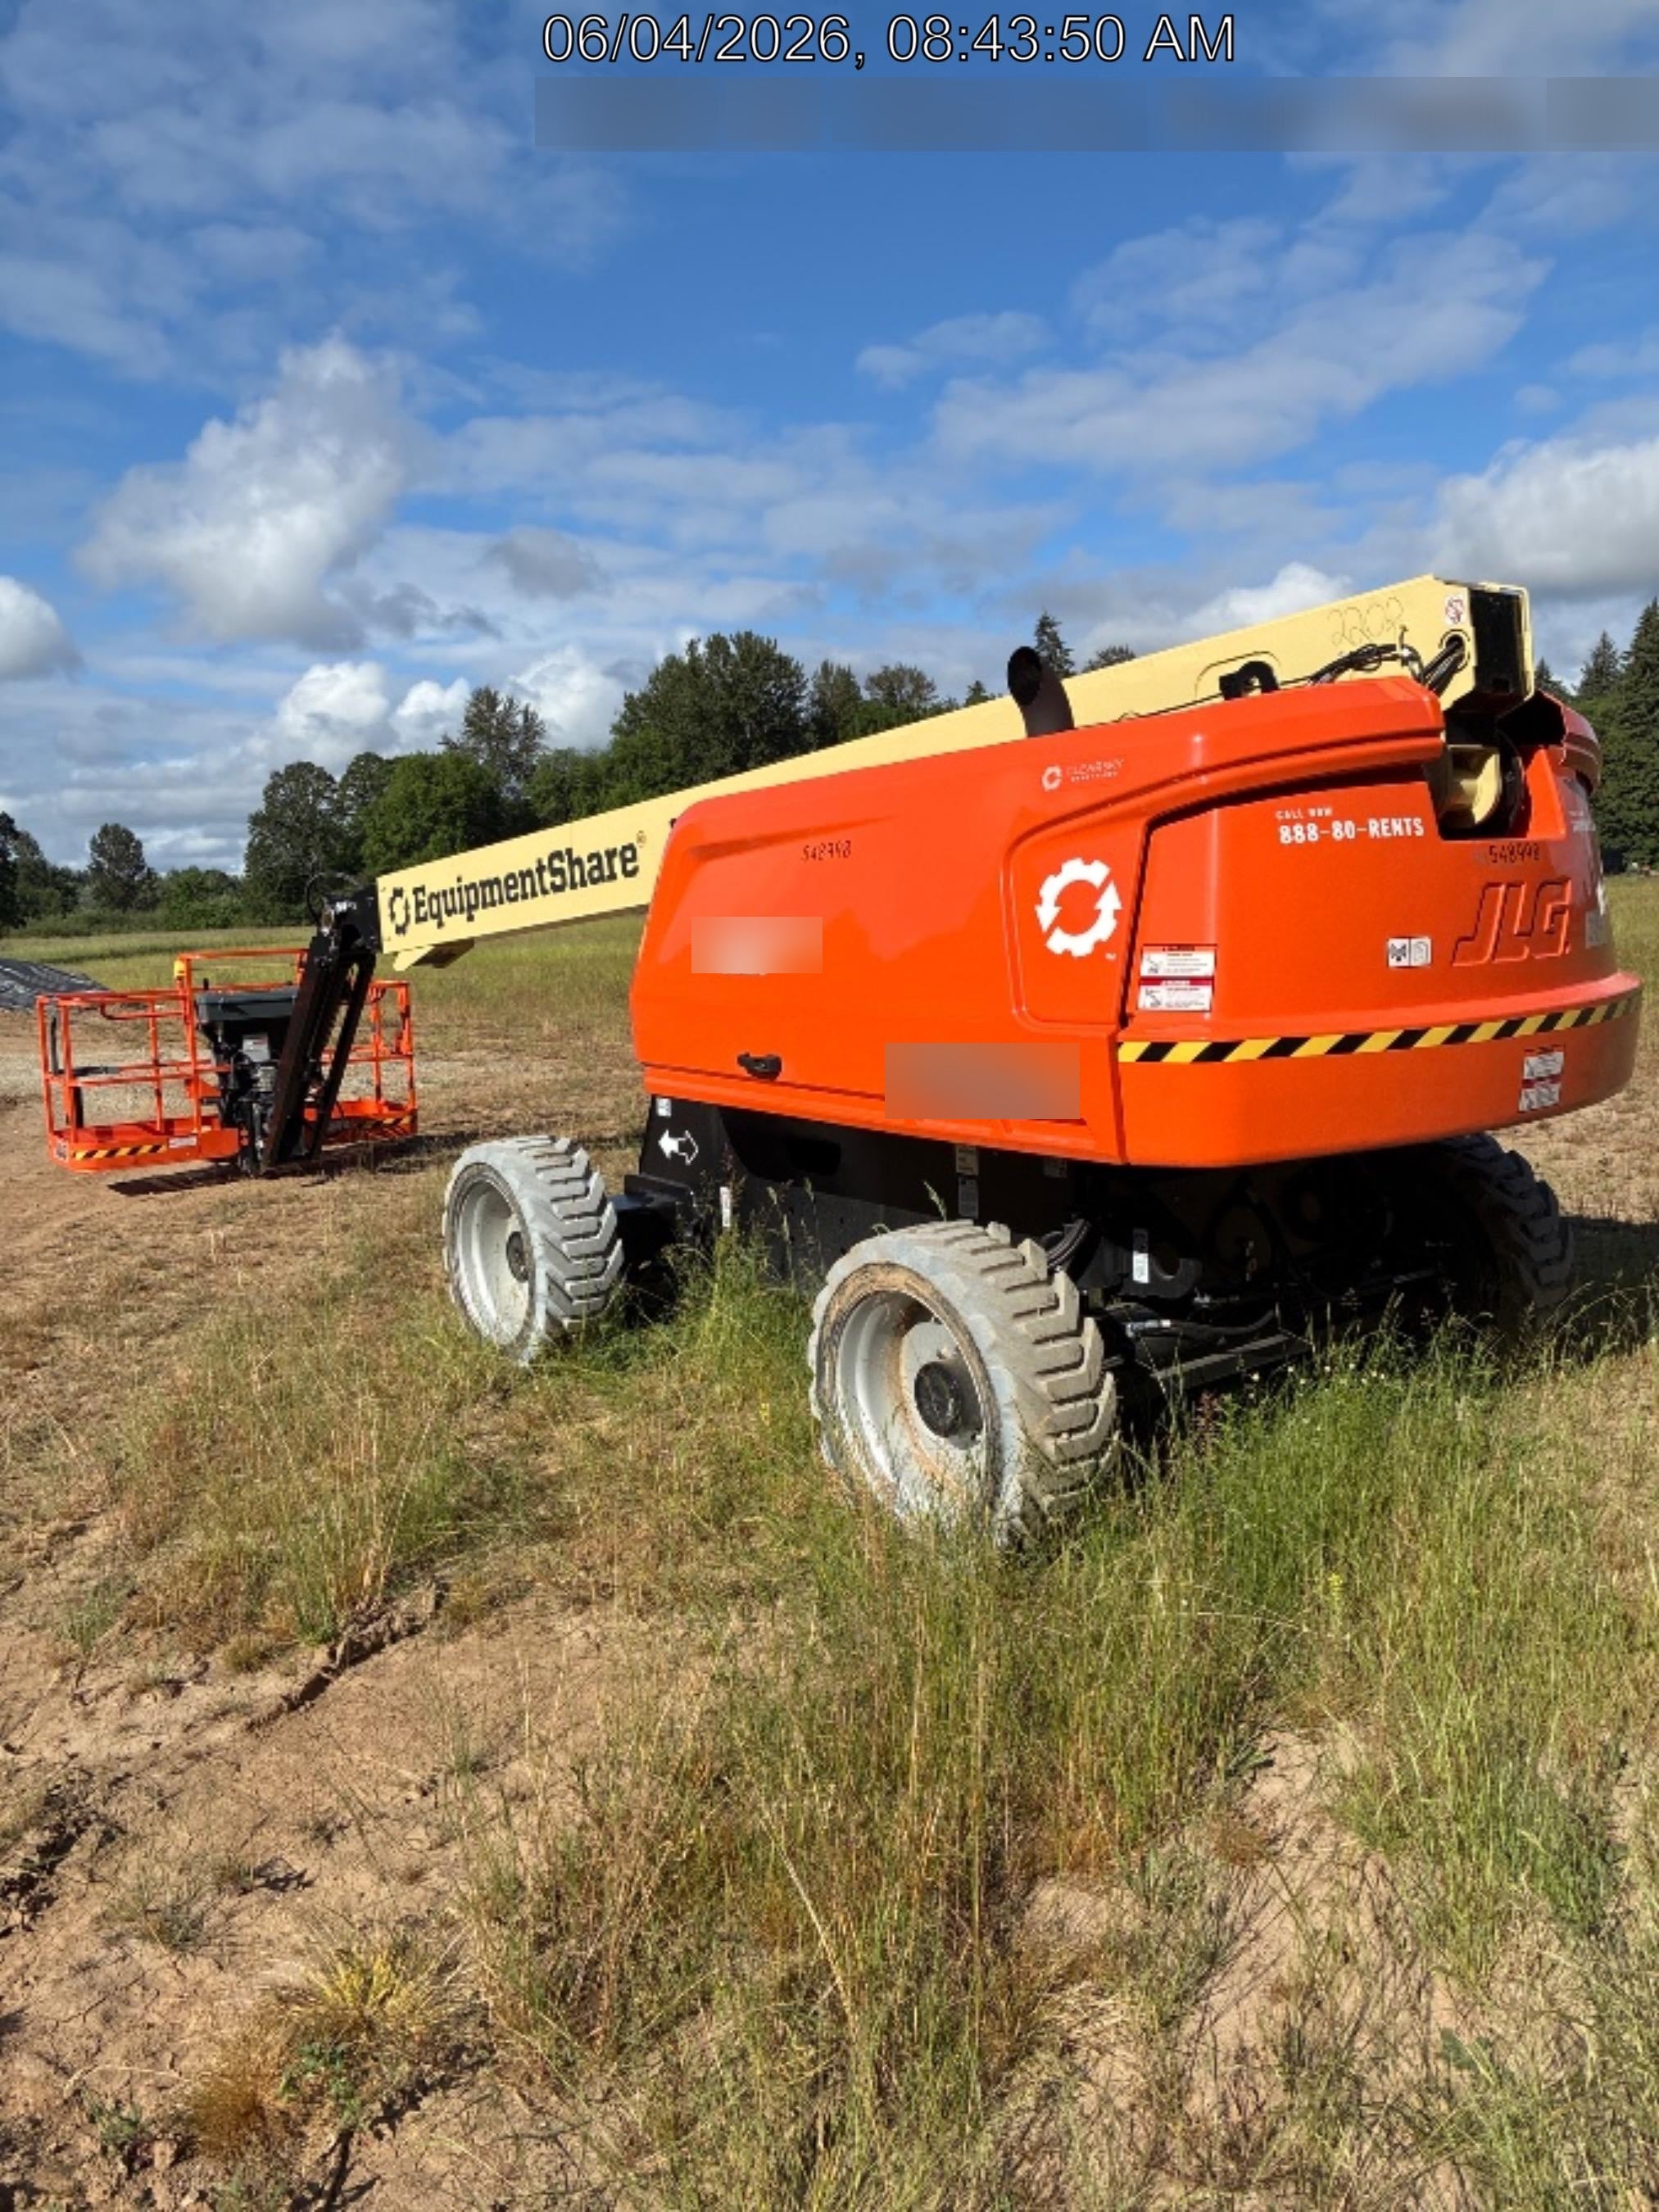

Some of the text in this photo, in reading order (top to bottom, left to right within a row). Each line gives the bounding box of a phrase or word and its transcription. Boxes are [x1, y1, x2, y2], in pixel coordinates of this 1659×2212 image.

[1280, 817, 1424, 845] 888-80-RENTS
[412, 842, 640, 929] EquipmentShare
[1451, 876, 1572, 968] JLG
